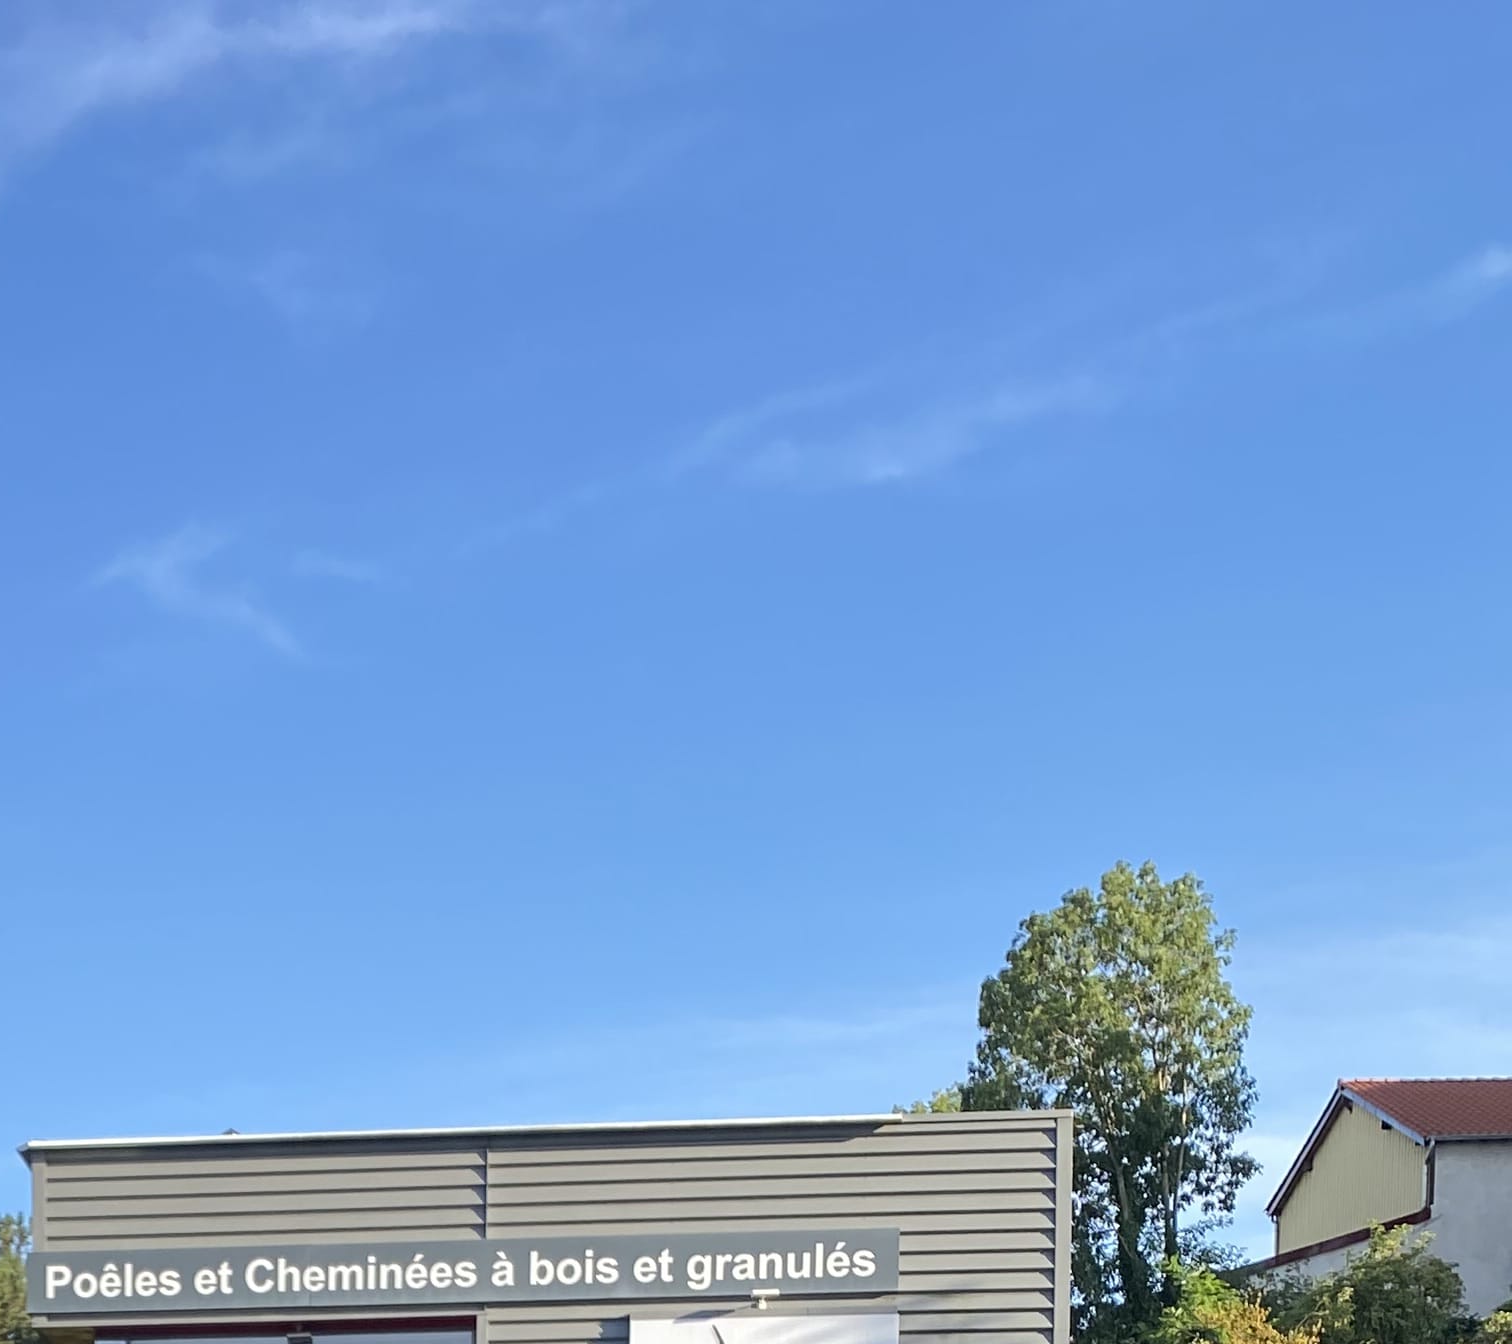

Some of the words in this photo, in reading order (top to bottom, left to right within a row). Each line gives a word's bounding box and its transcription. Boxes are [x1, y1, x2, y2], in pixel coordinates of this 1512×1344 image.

[44, 1262, 183, 1300] Poêles
[193, 1260, 234, 1296] et
[244, 1253, 479, 1294] Cheminées
[491, 1250, 515, 1287] à
[529, 1249, 620, 1286] bois
[633, 1248, 675, 1283] et
[687, 1242, 878, 1291] granulés
